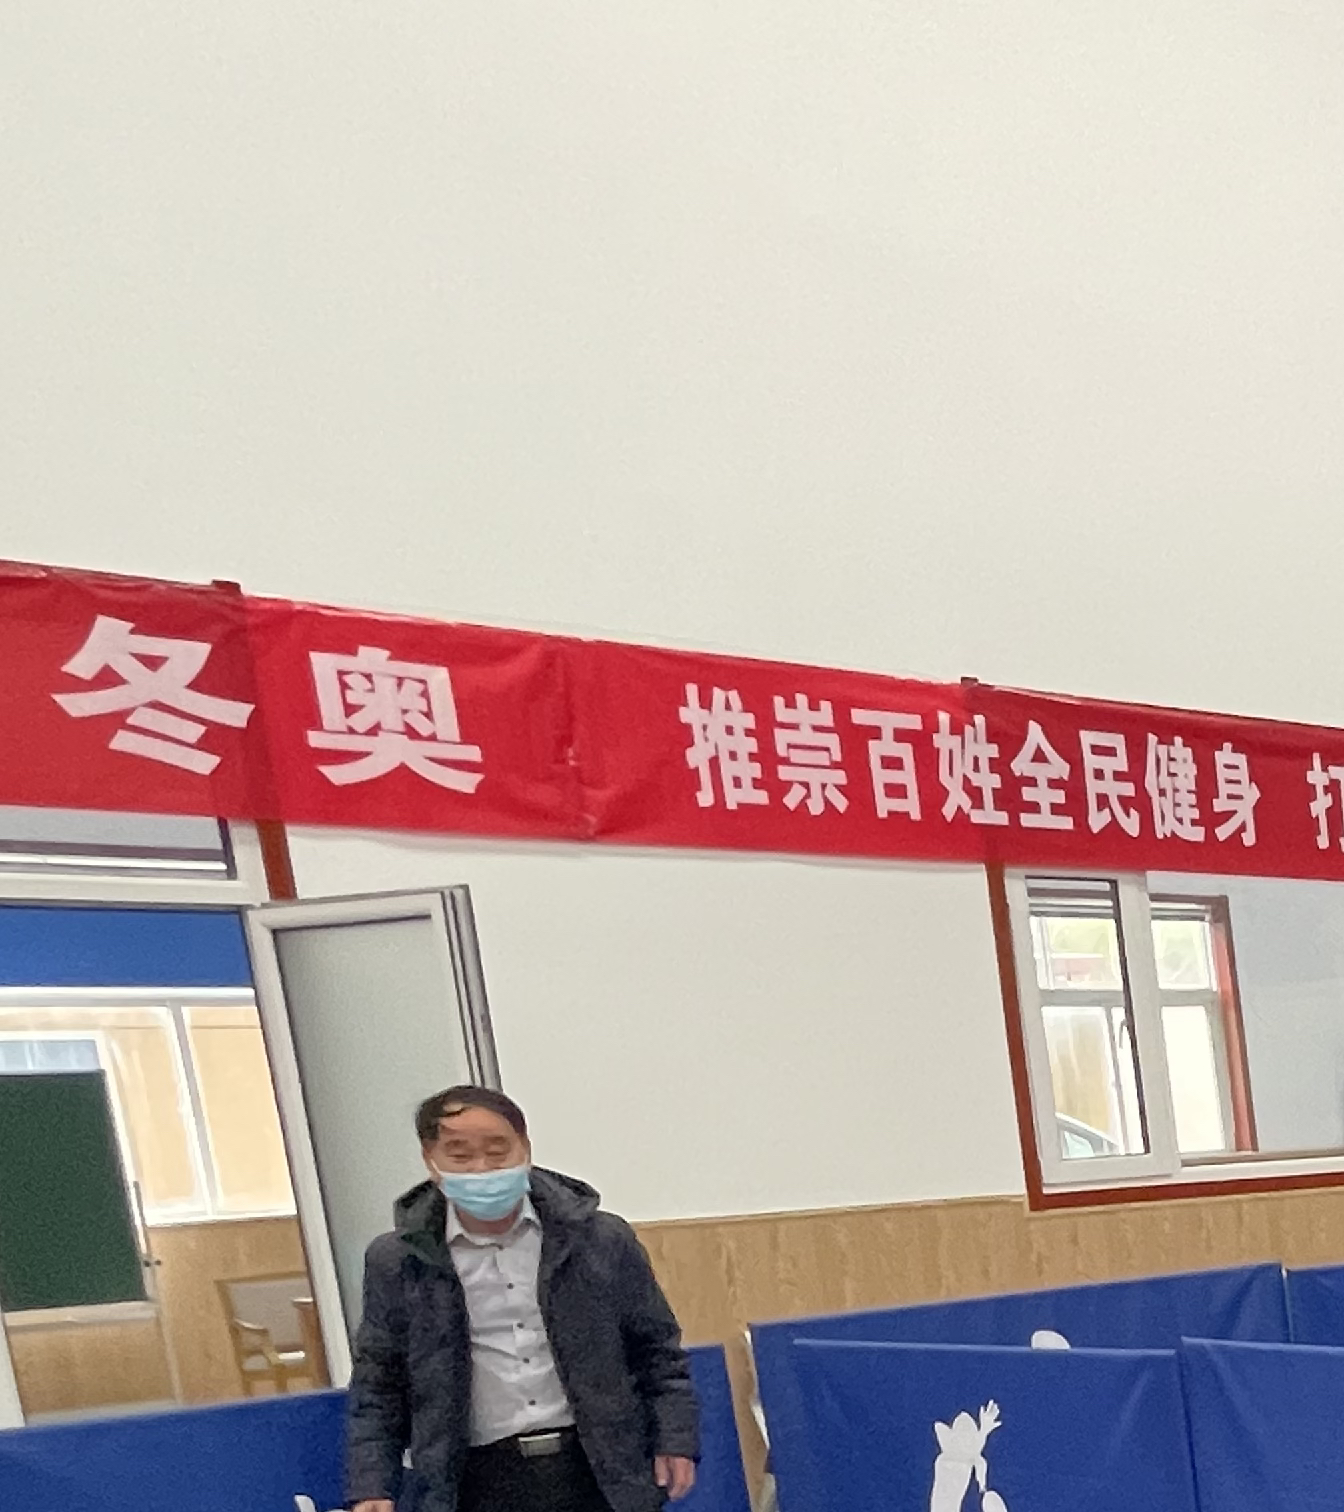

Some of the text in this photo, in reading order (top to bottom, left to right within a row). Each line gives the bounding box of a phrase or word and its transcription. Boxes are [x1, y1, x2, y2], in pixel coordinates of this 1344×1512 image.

[52, 615, 484, 793] 冬奥
[678, 683, 1261, 847] 推崇百姓全民健身
